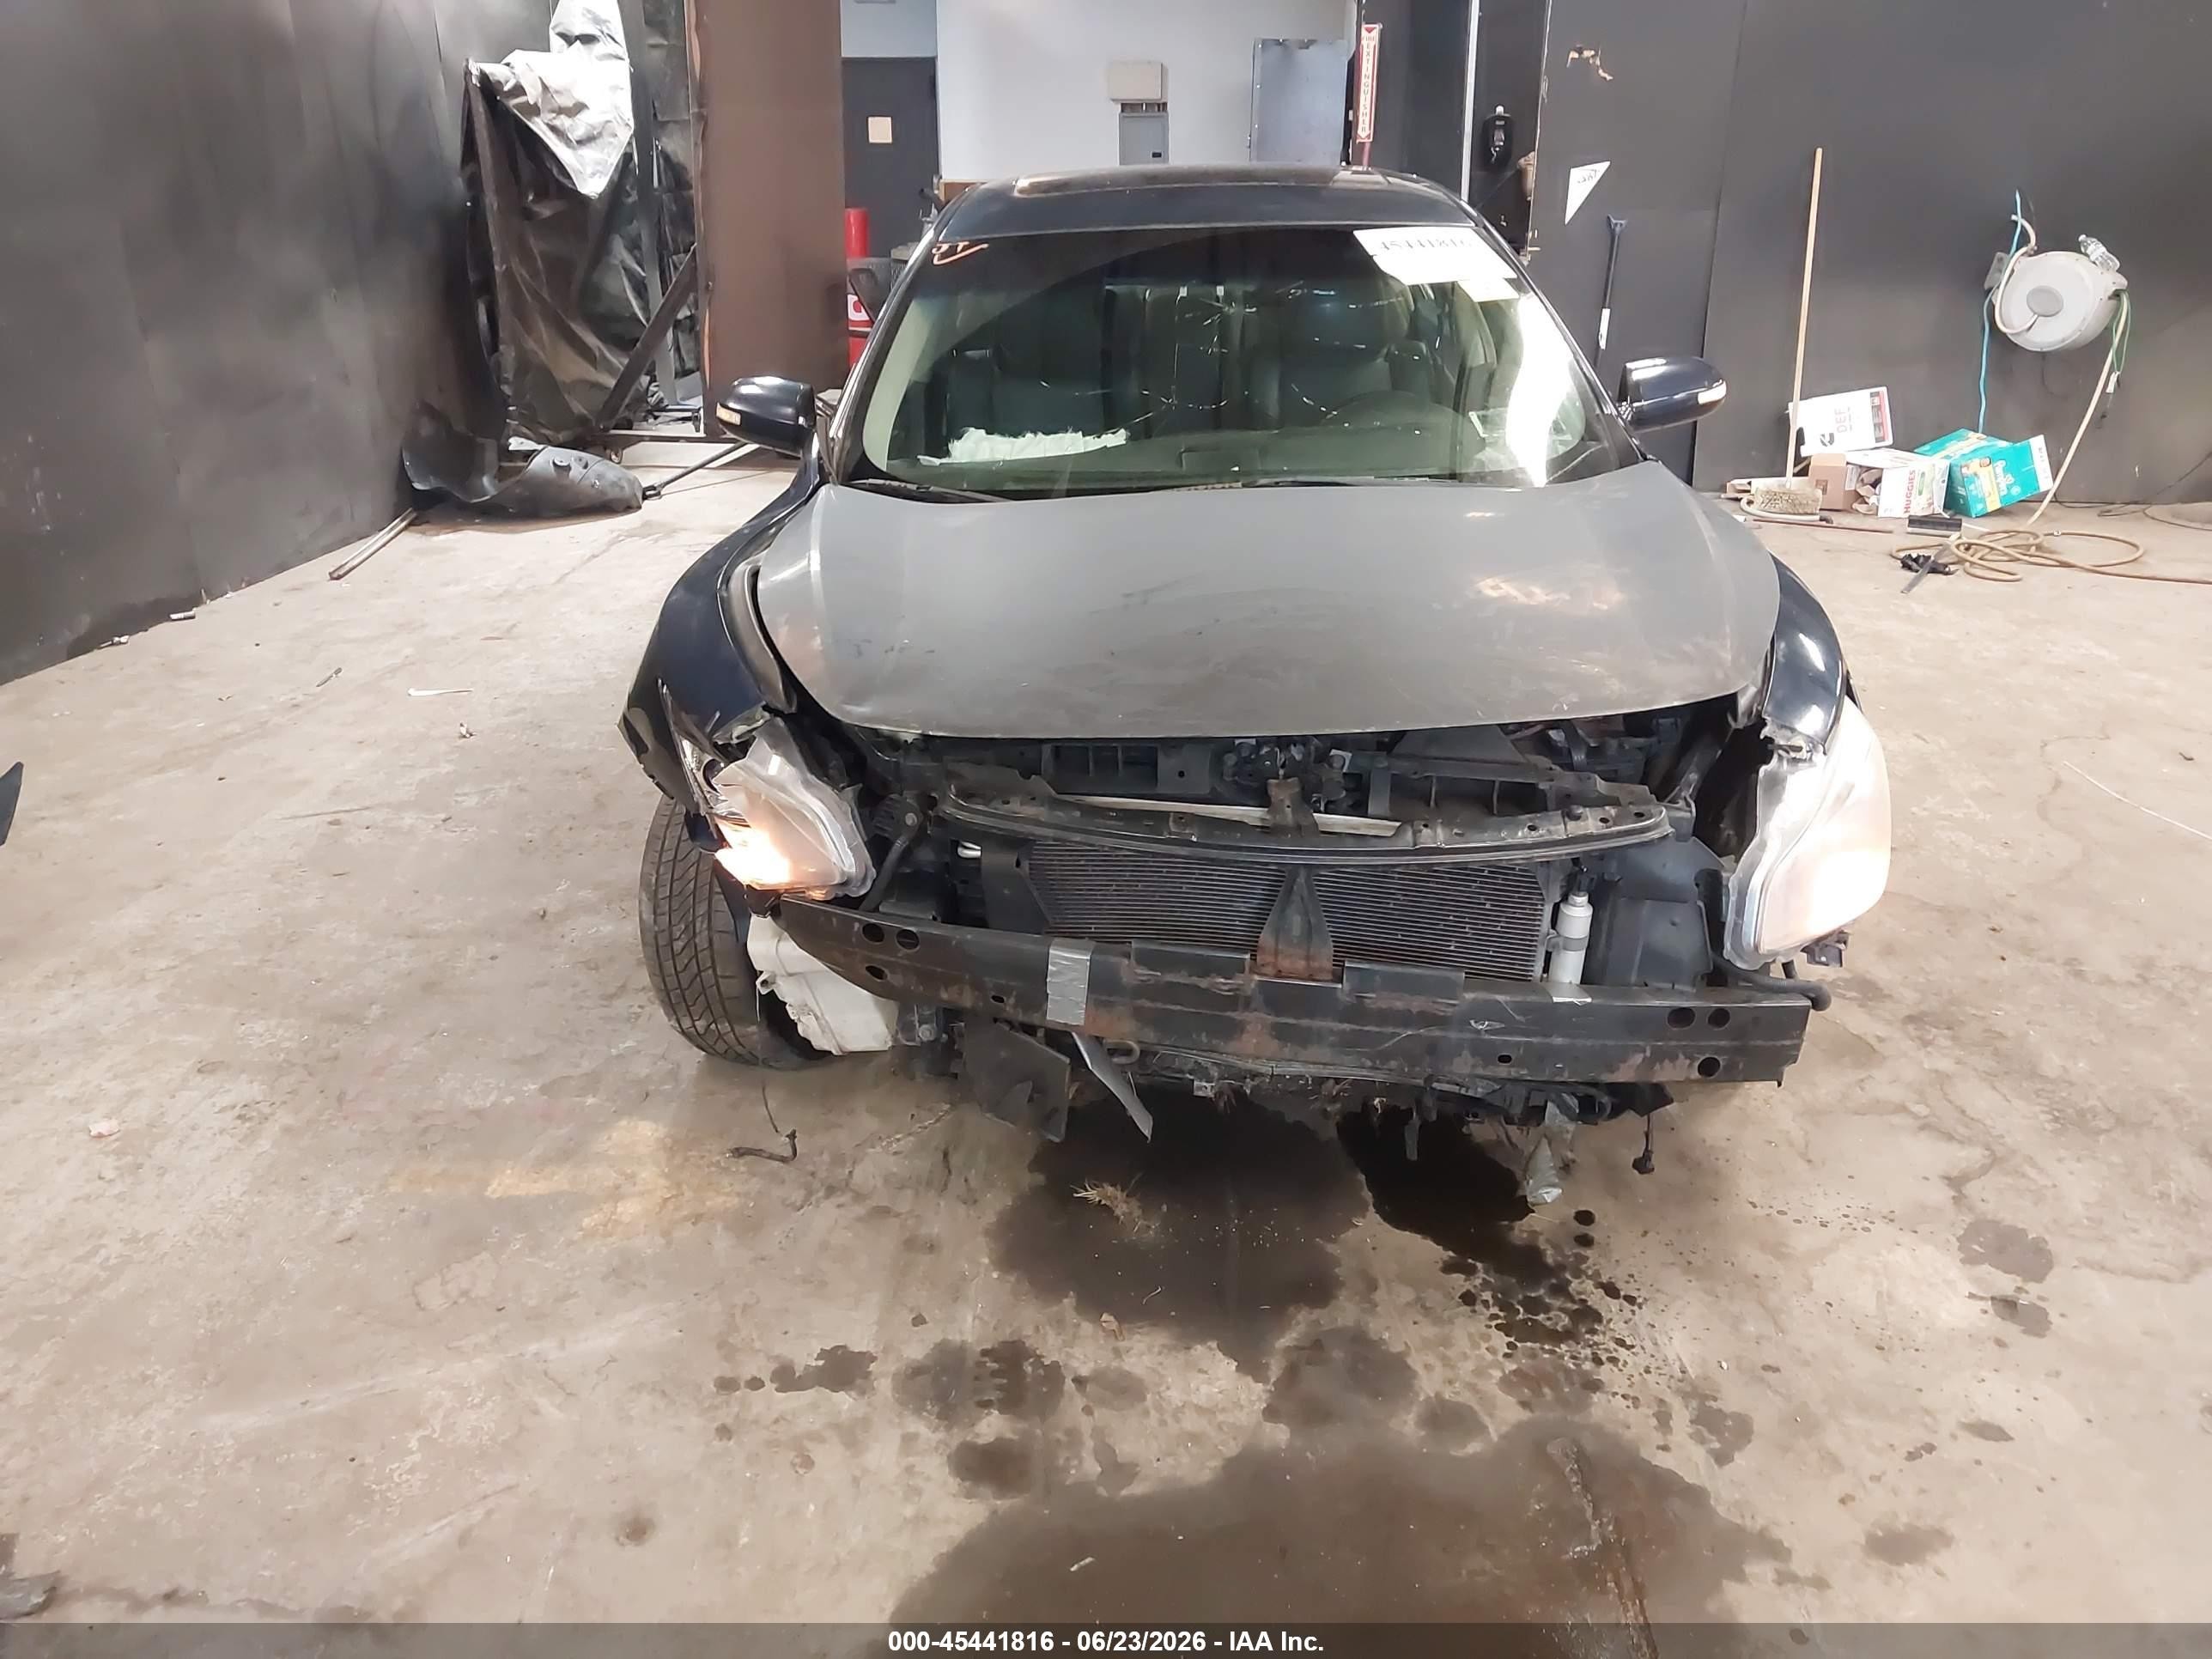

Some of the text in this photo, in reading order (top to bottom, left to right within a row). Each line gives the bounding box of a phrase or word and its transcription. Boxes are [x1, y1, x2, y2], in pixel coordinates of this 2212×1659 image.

[1361, 42, 1371, 133] EXTINGUISHER
[1834, 407, 1847, 434] DEF
[1903, 469, 1916, 514] HUGGIES
